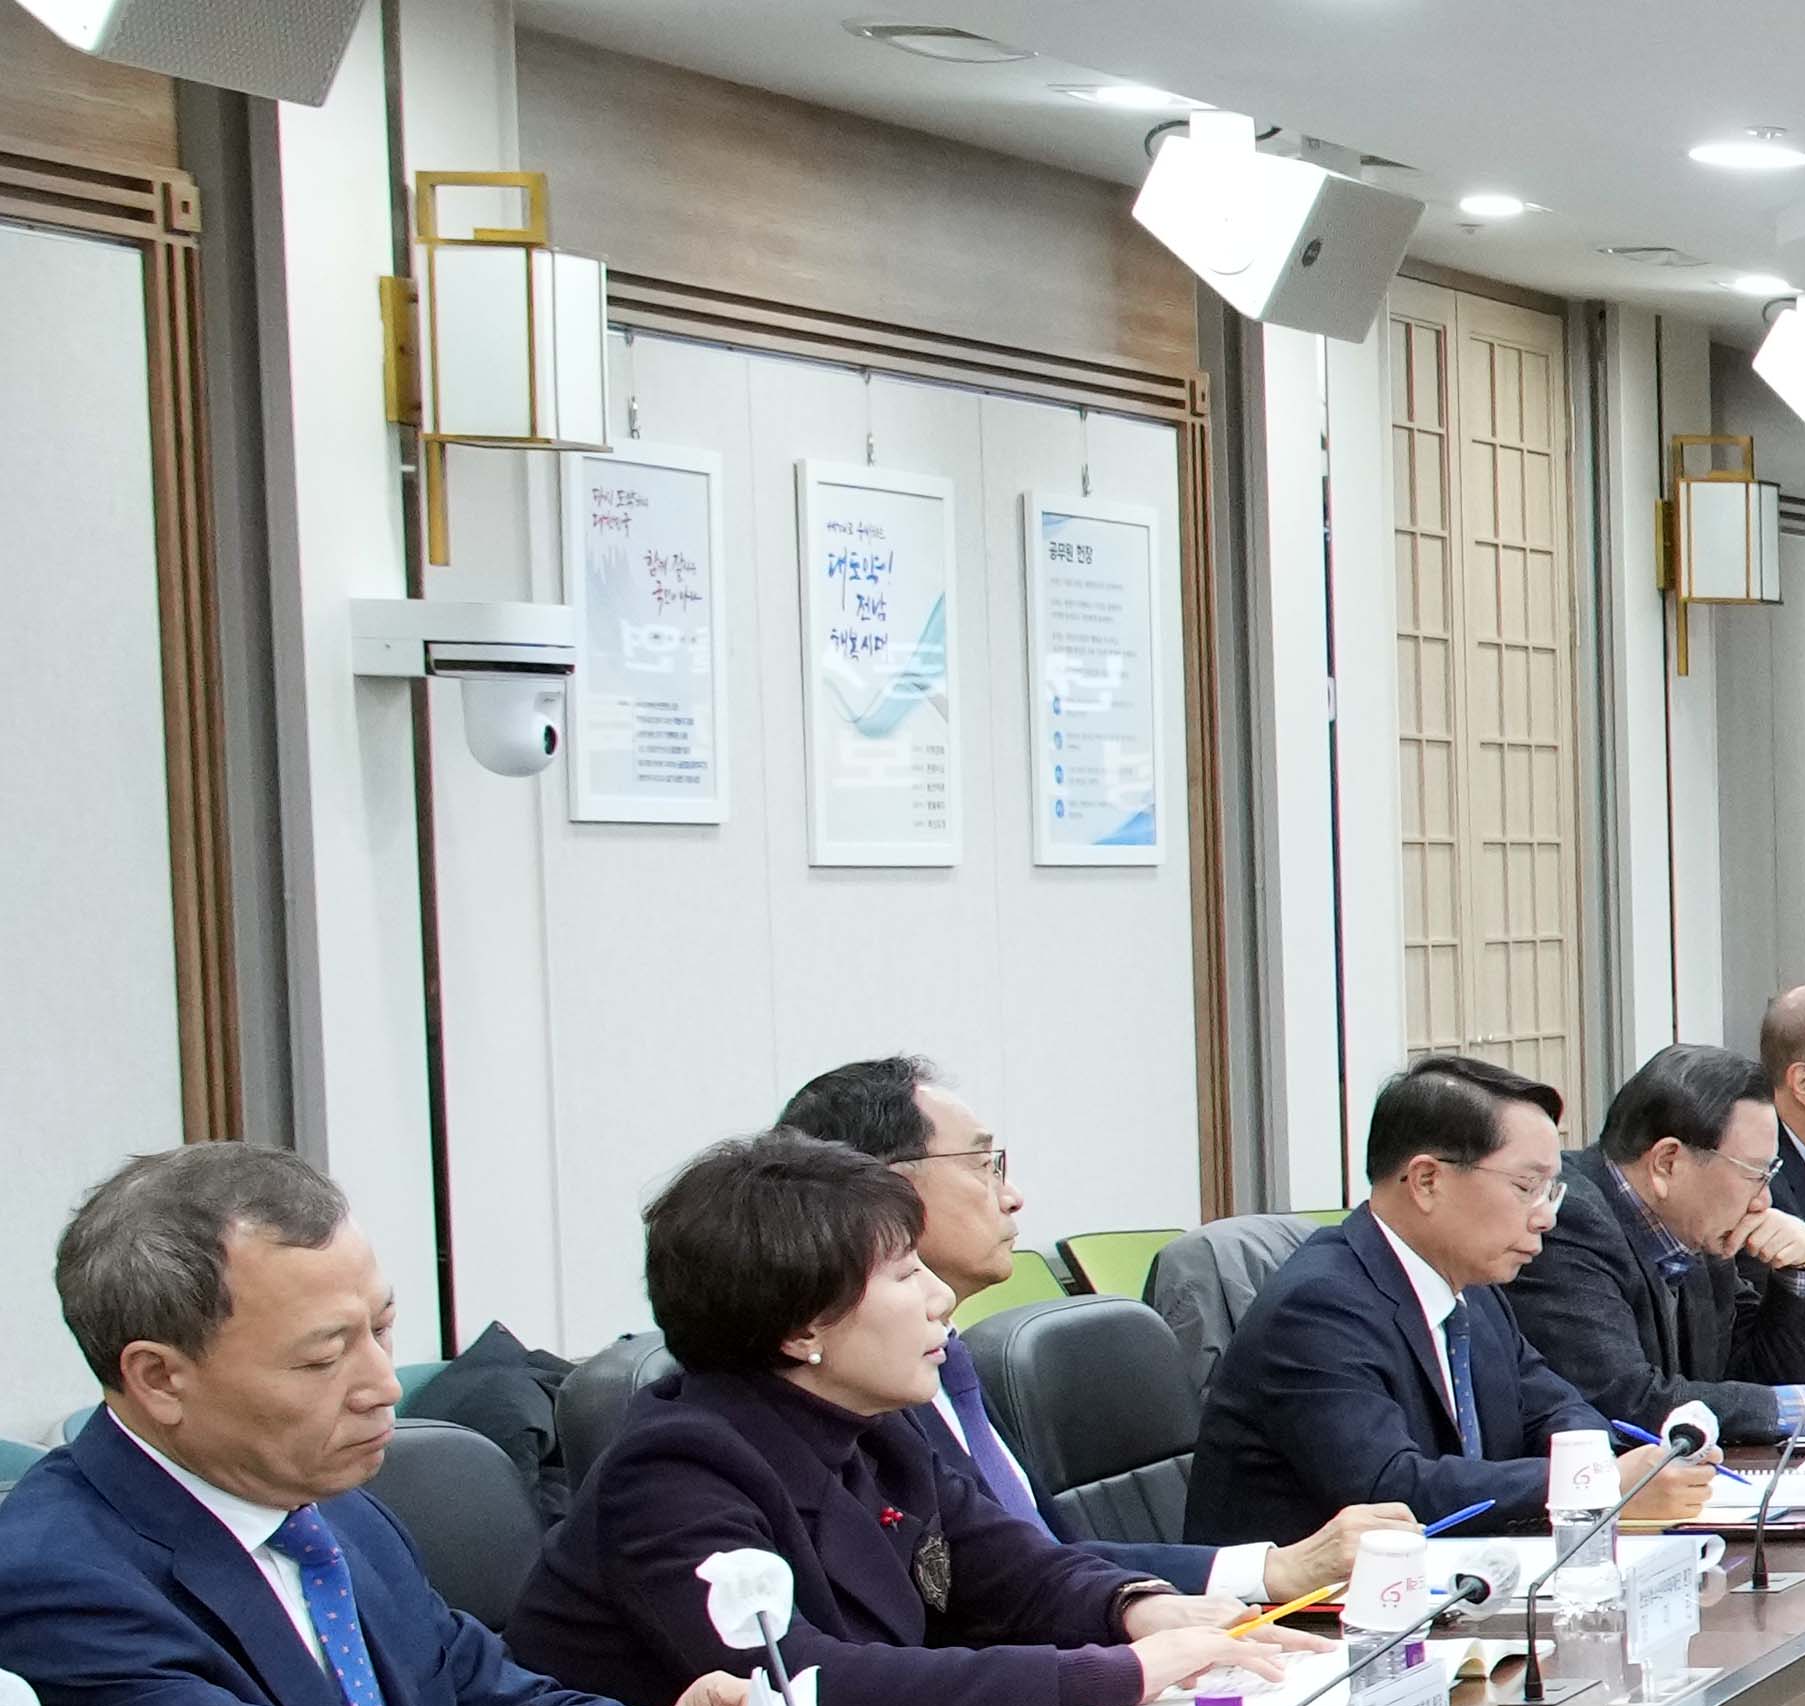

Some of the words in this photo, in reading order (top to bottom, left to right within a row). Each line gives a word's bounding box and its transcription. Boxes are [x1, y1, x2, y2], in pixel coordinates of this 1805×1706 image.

[1049, 541, 1073, 563] 공무원
[1077, 544, 1093, 565] 헌장
[856, 592, 887, 621] 전남
